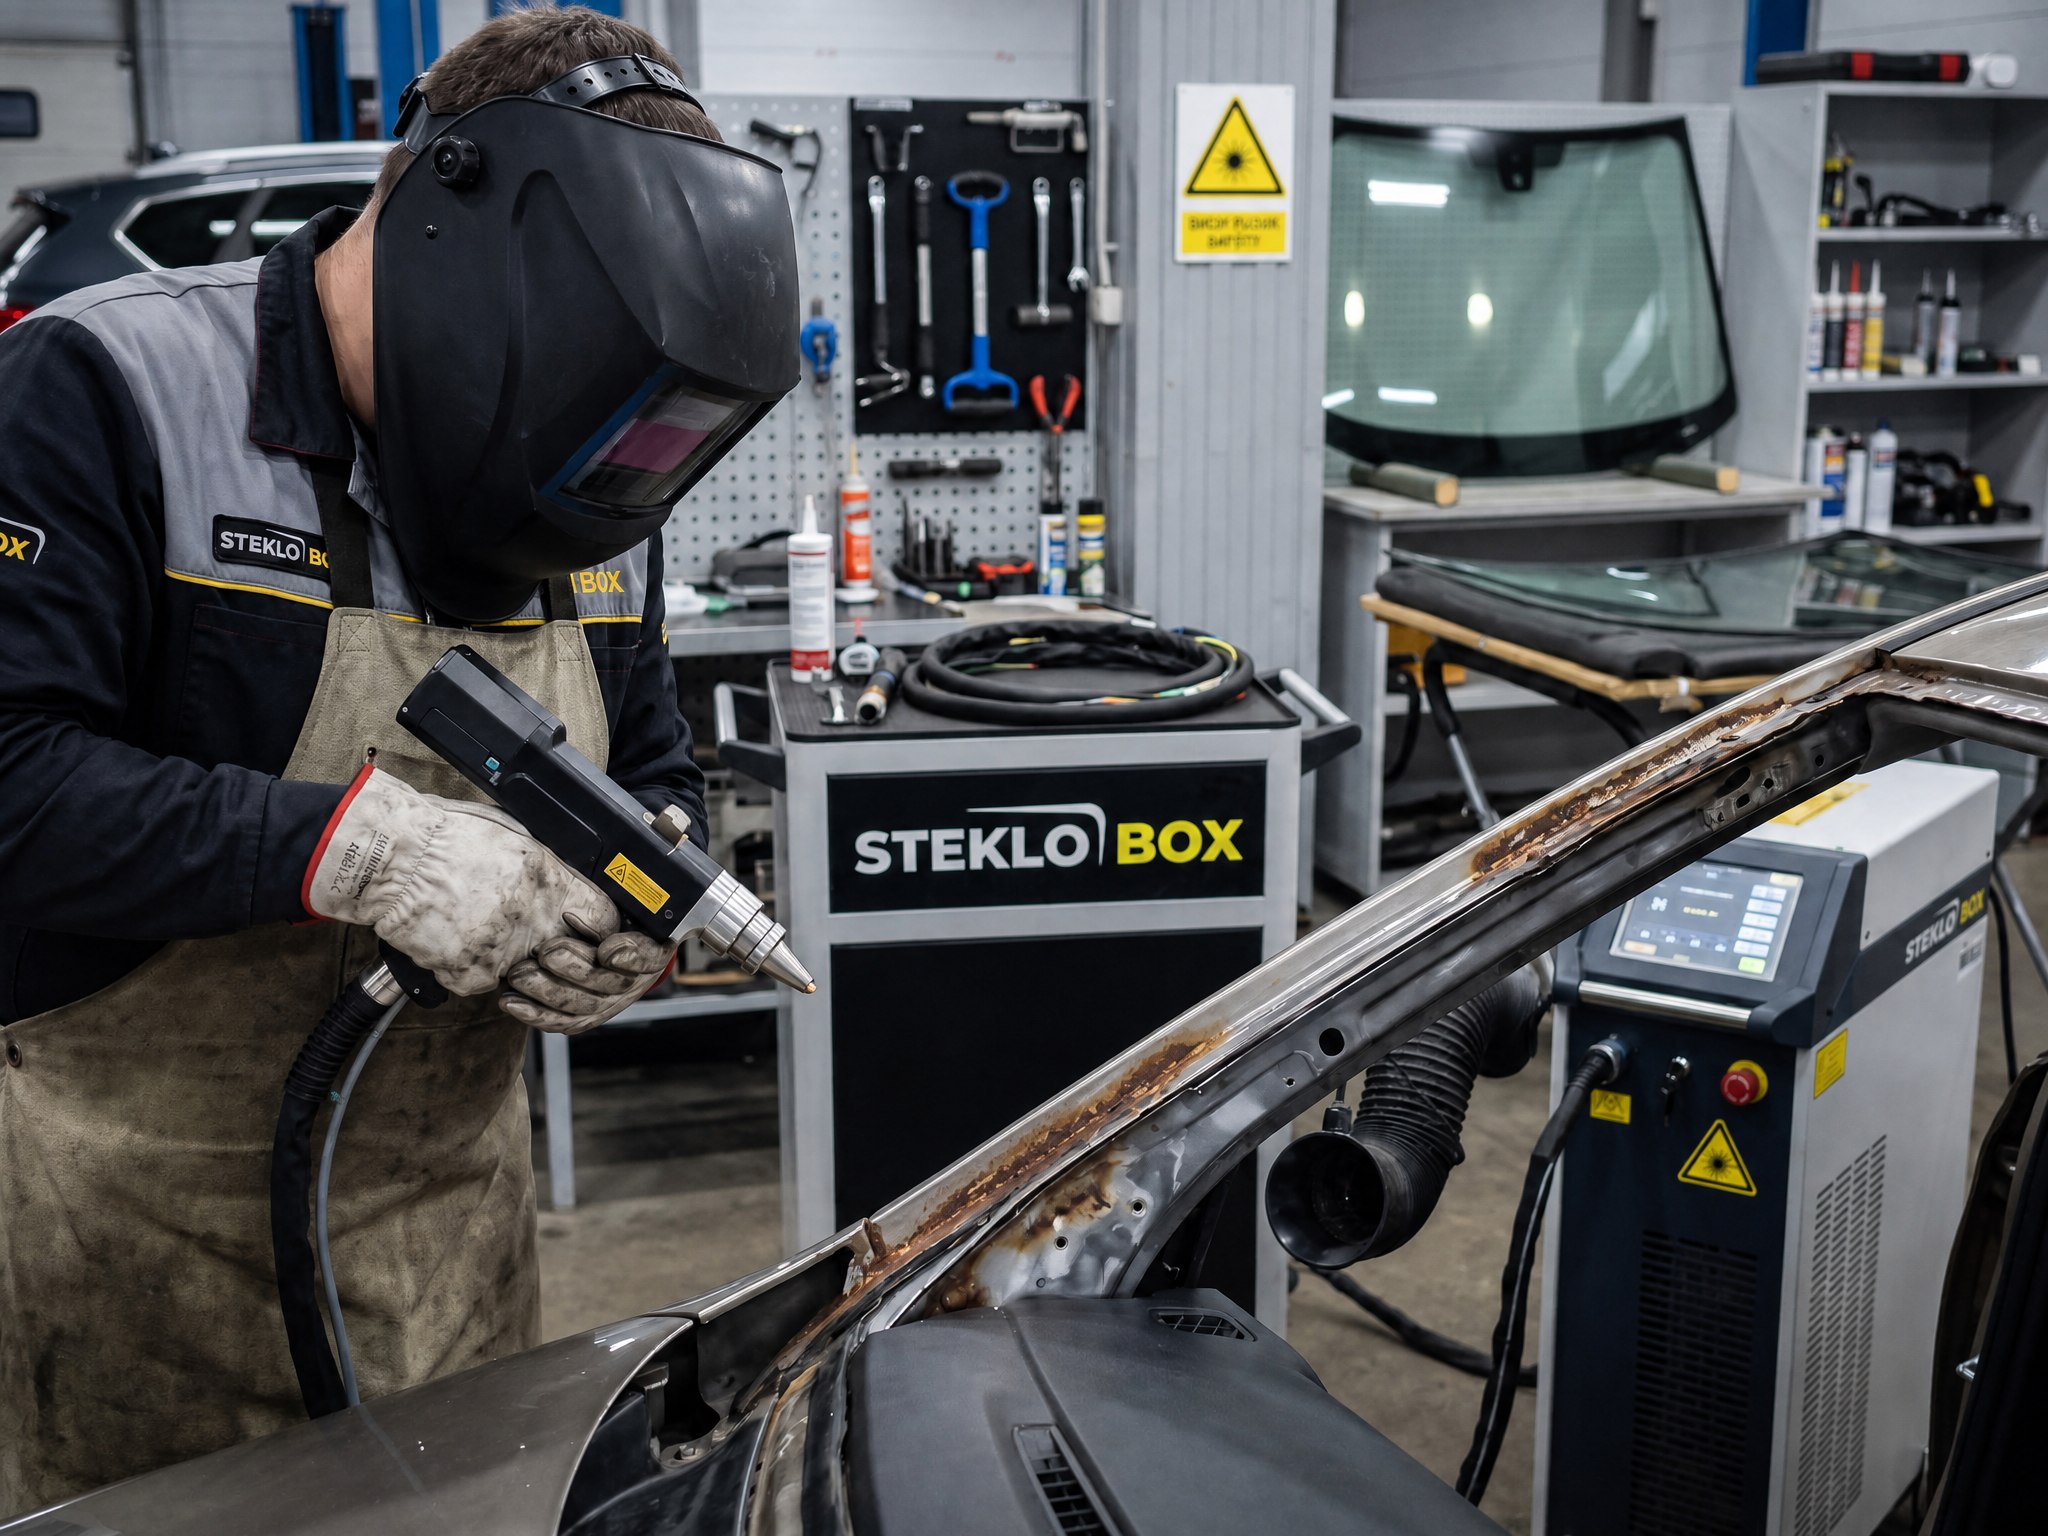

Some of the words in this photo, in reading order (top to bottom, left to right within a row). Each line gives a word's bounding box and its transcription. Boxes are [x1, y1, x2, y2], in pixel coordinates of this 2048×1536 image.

[220, 531, 301, 561] STEKLO
[854, 823, 1090, 875] STEKLO
[1116, 818, 1244, 865] BOX
[1905, 908, 1956, 965] STEKLO
[1960, 887, 1985, 925] BOX
